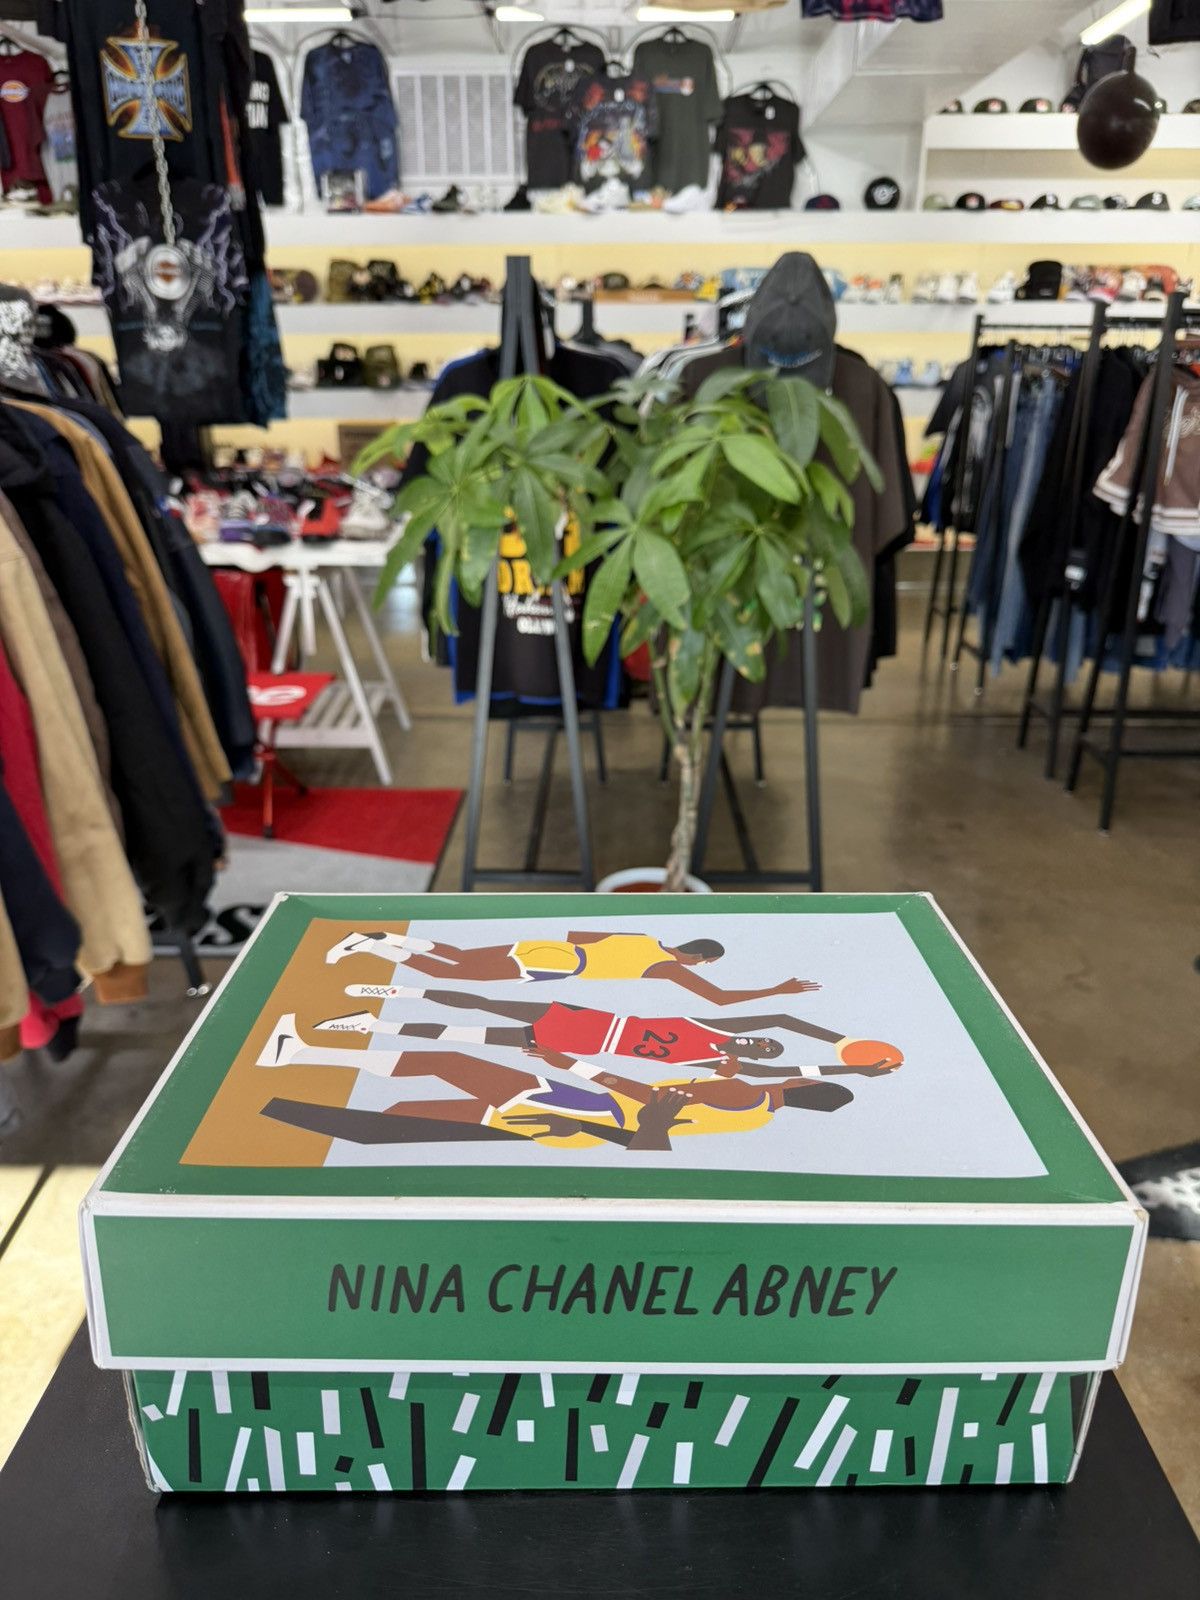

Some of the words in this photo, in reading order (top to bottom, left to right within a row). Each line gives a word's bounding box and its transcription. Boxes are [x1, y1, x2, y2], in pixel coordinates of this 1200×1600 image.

[632, 1029, 679, 1059] 23
[326, 1263, 466, 1314] NINA
[488, 1261, 699, 1316] CHANEL
[711, 1263, 899, 1319] ABNEY
